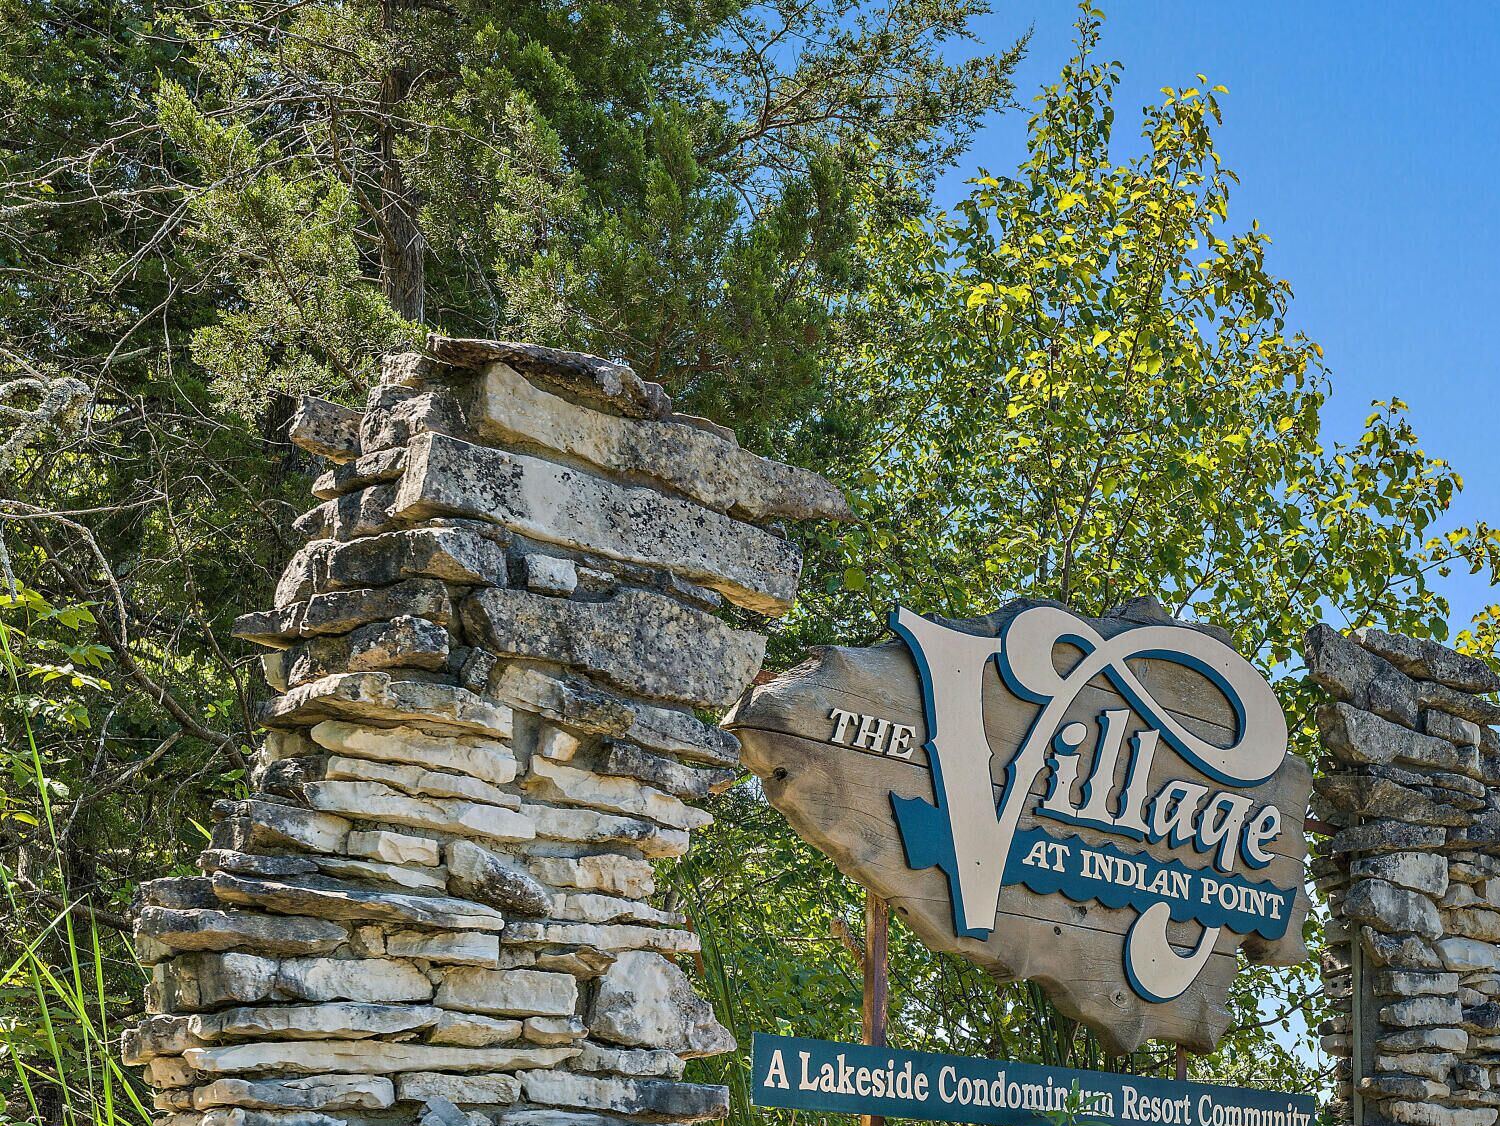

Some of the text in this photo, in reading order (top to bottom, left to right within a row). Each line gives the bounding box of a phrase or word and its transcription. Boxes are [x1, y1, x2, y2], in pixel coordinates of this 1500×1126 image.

[829, 604, 1289, 999] THE Village
[1021, 840, 1285, 920] AT INDIAN POINT
[763, 1049, 790, 1090] A
[798, 1050, 930, 1101] Lakeside
[938, 1065, 1115, 1118] Condominum
[1121, 1085, 1192, 1126] Resort
